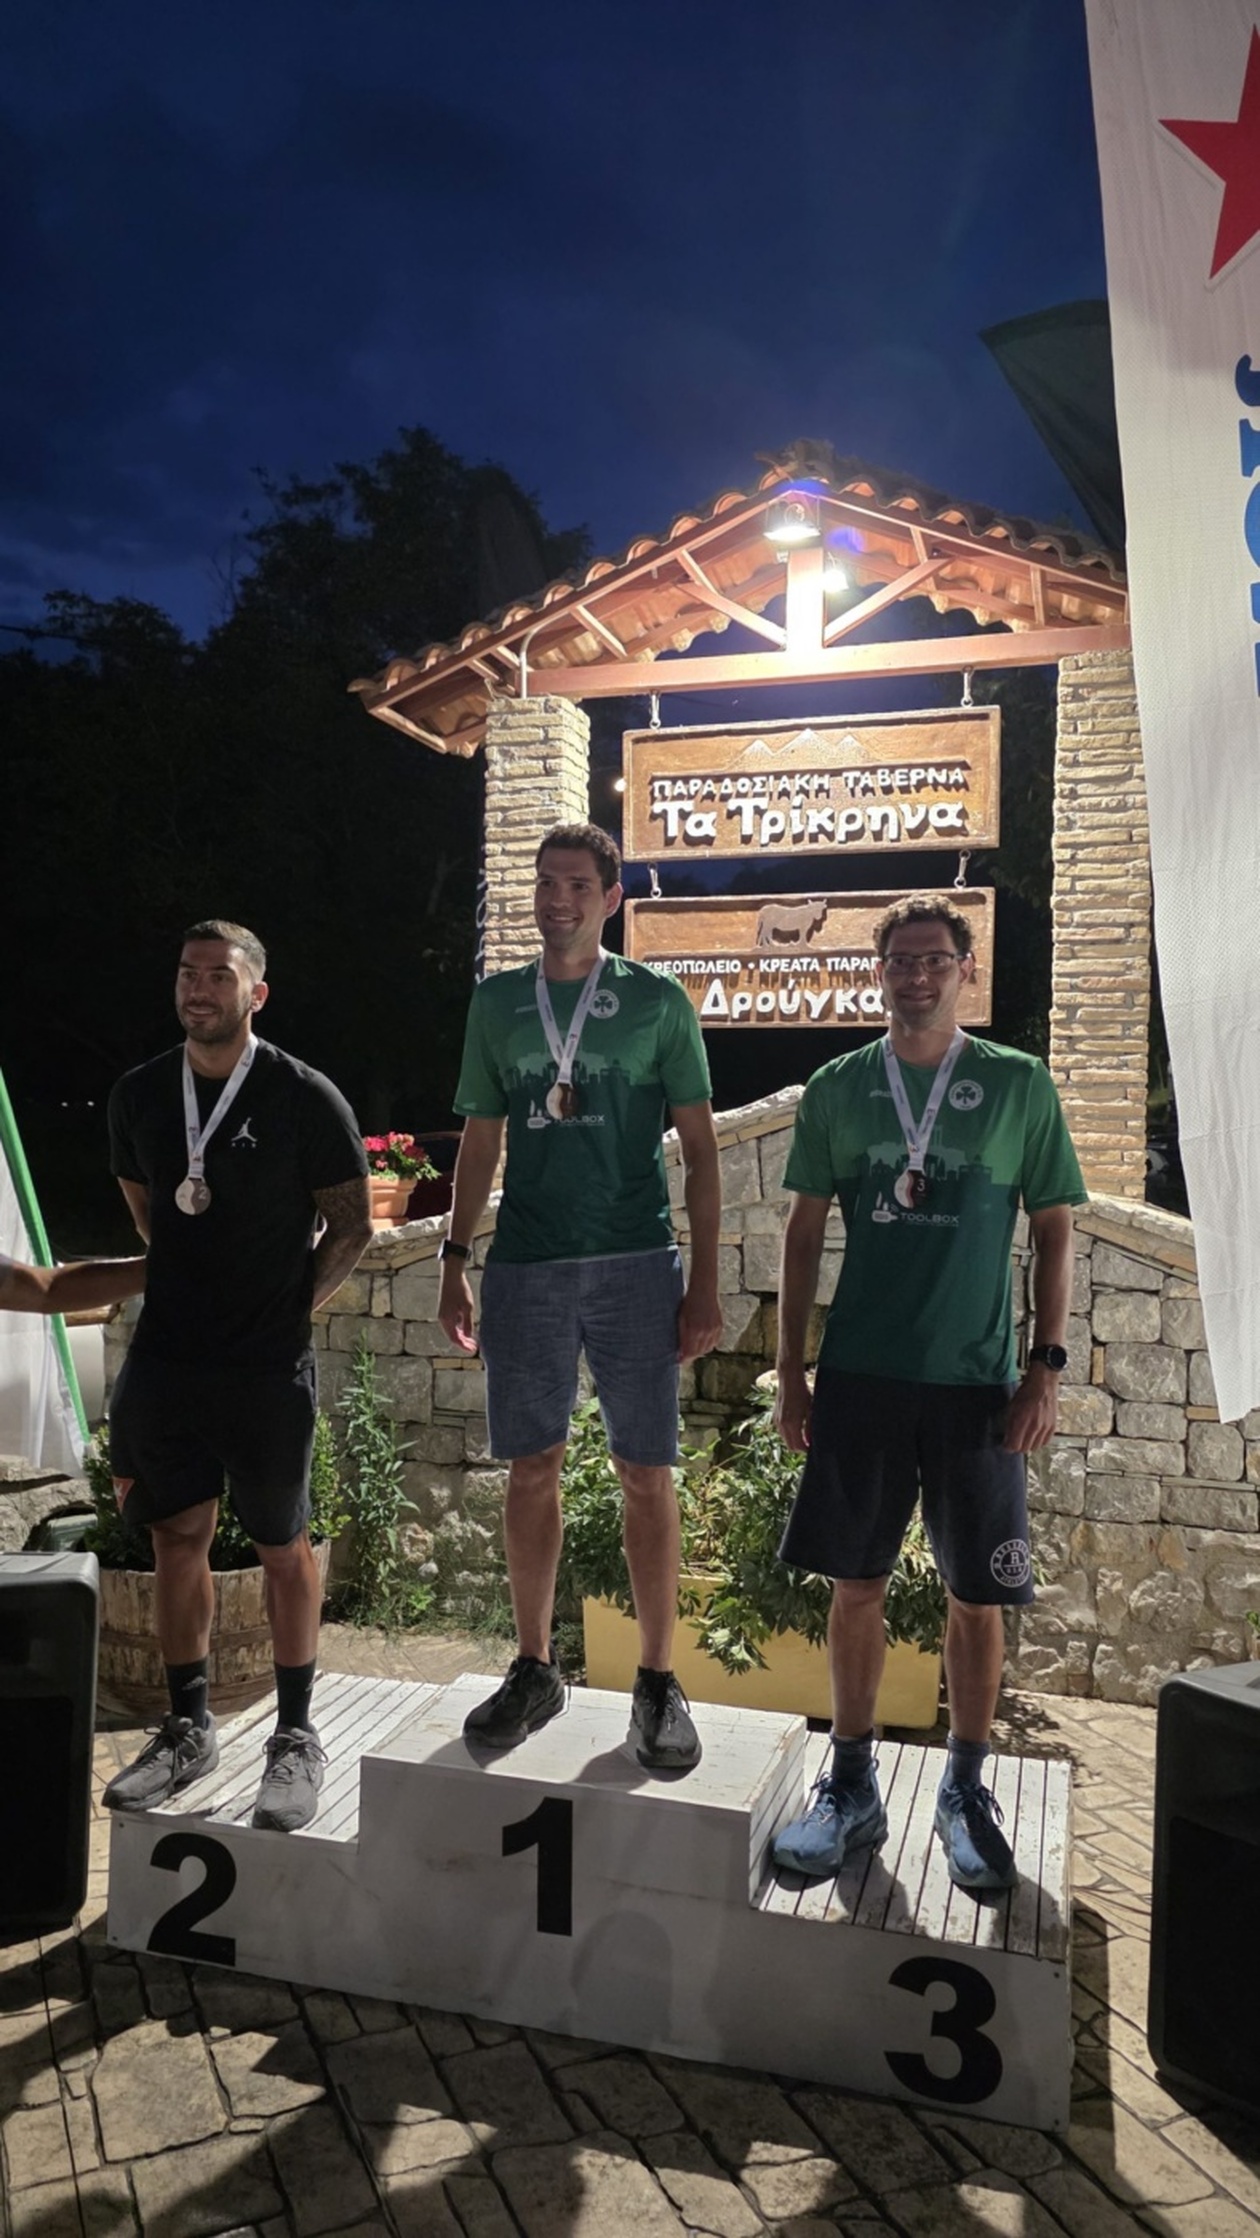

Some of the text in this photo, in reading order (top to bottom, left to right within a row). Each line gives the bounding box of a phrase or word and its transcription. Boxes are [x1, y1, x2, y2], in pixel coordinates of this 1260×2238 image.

[652, 767, 964, 798] ΠΑΡΑΔΟΣΙΑΚΗ ΤΑΒΕΡΝΑ
[652, 795, 964, 845] Τα Τρίκρηνα
[759, 957, 820, 973] ΚΡΕΑΤΑ
[700, 978, 892, 1019] Δρούγκα
[900, 1212, 960, 1224] TOOLBOX
[501, 1797, 573, 1937] 1
[147, 1831, 238, 1967] 2
[883, 1956, 1003, 2105] 3
